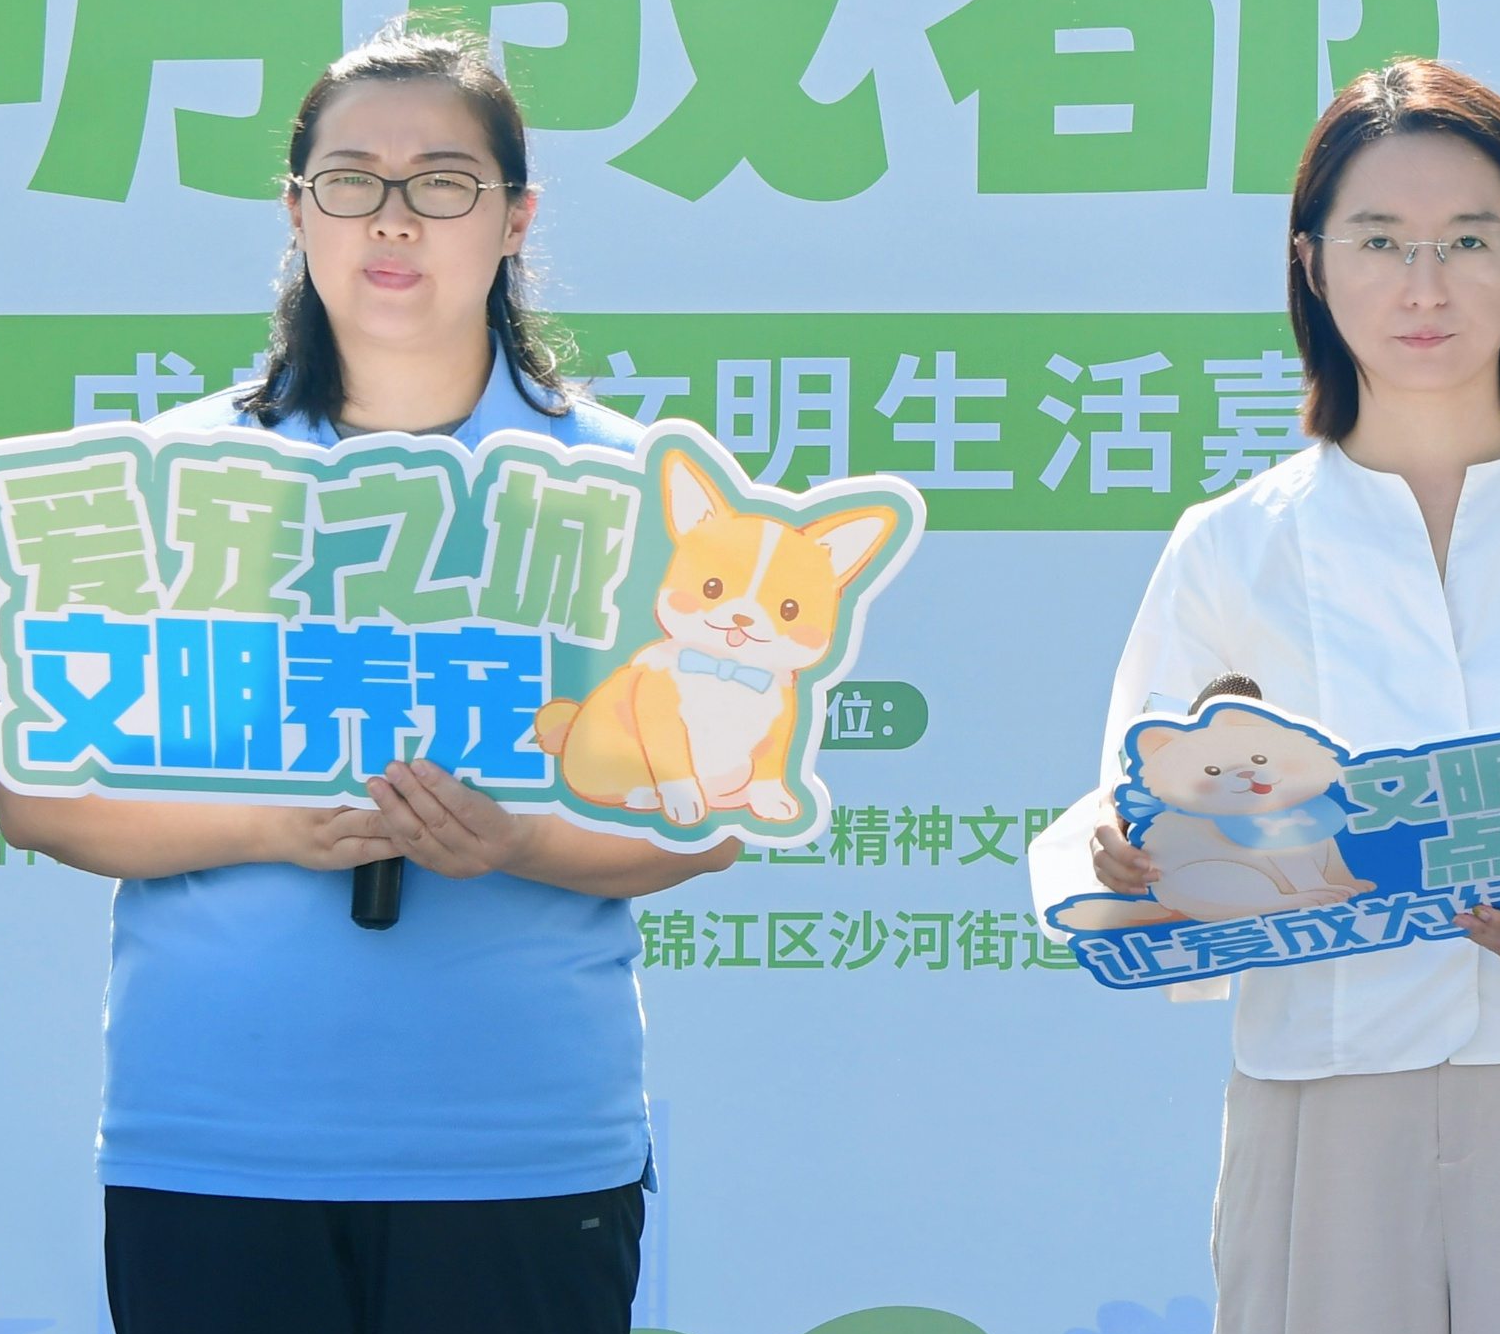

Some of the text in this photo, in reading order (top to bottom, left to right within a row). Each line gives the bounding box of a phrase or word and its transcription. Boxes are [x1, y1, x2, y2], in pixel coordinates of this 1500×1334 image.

[4, 462, 632, 640] 爱宠之城
[21, 613, 553, 781] 文明养宠
